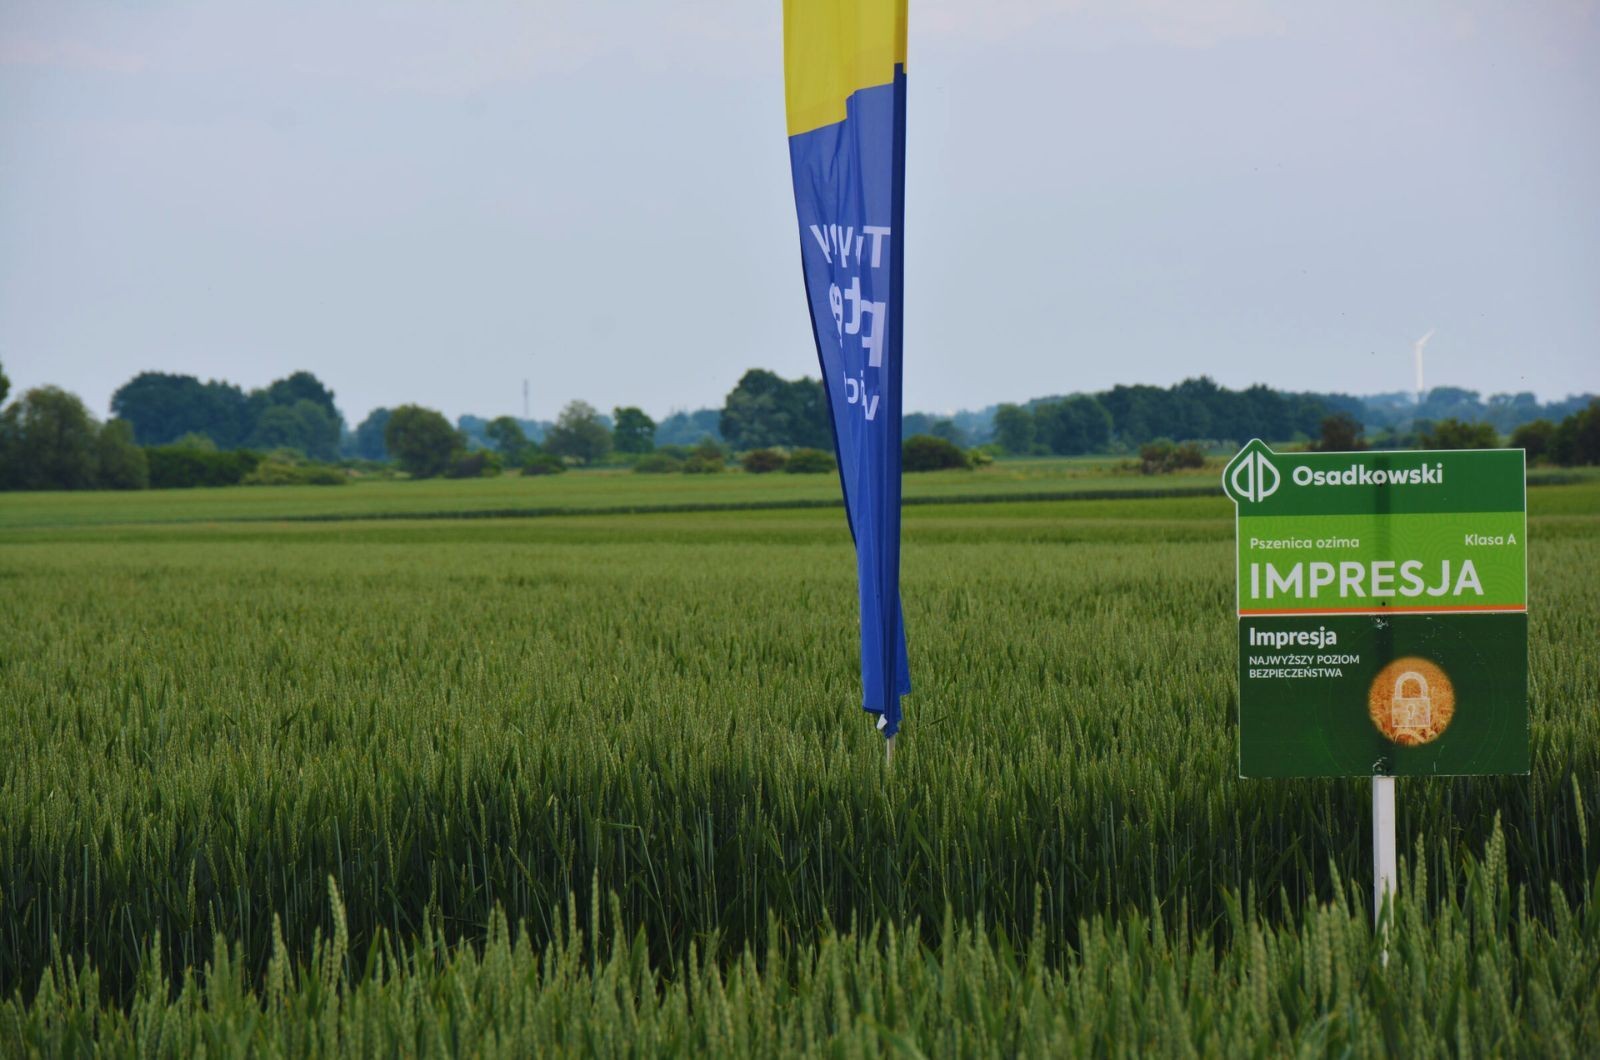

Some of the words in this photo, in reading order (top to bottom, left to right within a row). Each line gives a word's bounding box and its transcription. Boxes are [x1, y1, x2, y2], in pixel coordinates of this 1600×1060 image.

[1292, 463, 1443, 486] Osadkowski
[1250, 537, 1312, 549] Pszenica
[1316, 536, 1360, 548] ozima
[1465, 534, 1504, 546] Klasa
[1507, 533, 1517, 545] A
[1251, 559, 1484, 599] IMPRESJA
[1250, 626, 1337, 649] Impresja
[1249, 653, 1314, 665] NAJWYŻSZY
[1317, 654, 1360, 665] POZIOM
[1249, 666, 1343, 679] BEZPIECZEŃSTWA
